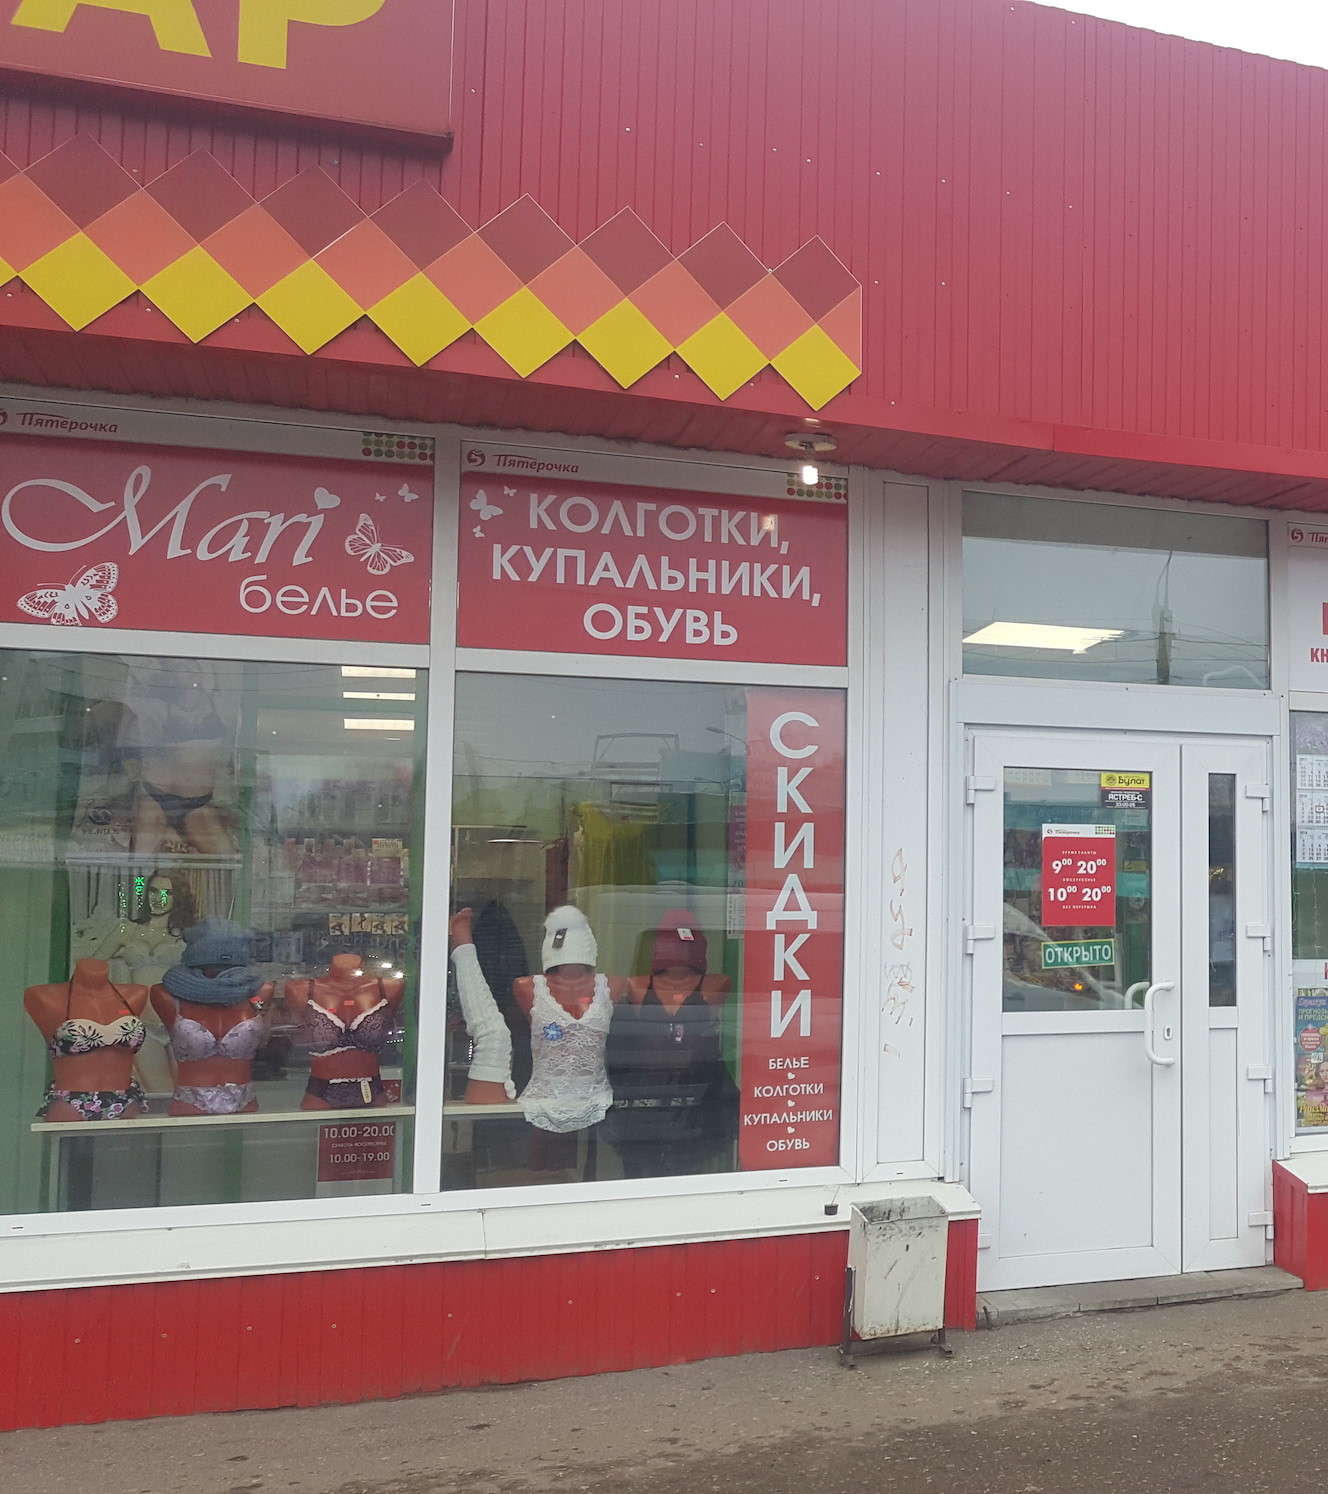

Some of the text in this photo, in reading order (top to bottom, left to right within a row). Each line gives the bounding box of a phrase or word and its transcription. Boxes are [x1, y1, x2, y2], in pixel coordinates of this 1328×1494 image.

[2, 465, 325, 566] Mari
[529, 493, 790, 554] КОЛГОТКИ,
[492, 543, 821, 607] КУПАЛЬНИКИ,
[239, 575, 398, 619] белье
[583, 603, 738, 646] ОБУВЬ
[1118, 776, 1145, 786] Булат
[766, 711, 820, 1038] СКИДКИ
[1045, 945, 1112, 964] ОТКРЫТО
[768, 1057, 810, 1070] БЕЛЬЕ
[754, 1083, 824, 1098] КОЛГОТКИ
[743, 1109, 833, 1126] КУПАЛЬНИКИ
[766, 1138, 810, 1152] ОБУВЬ
[329, 1152, 390, 1163] 10.00-19.00
